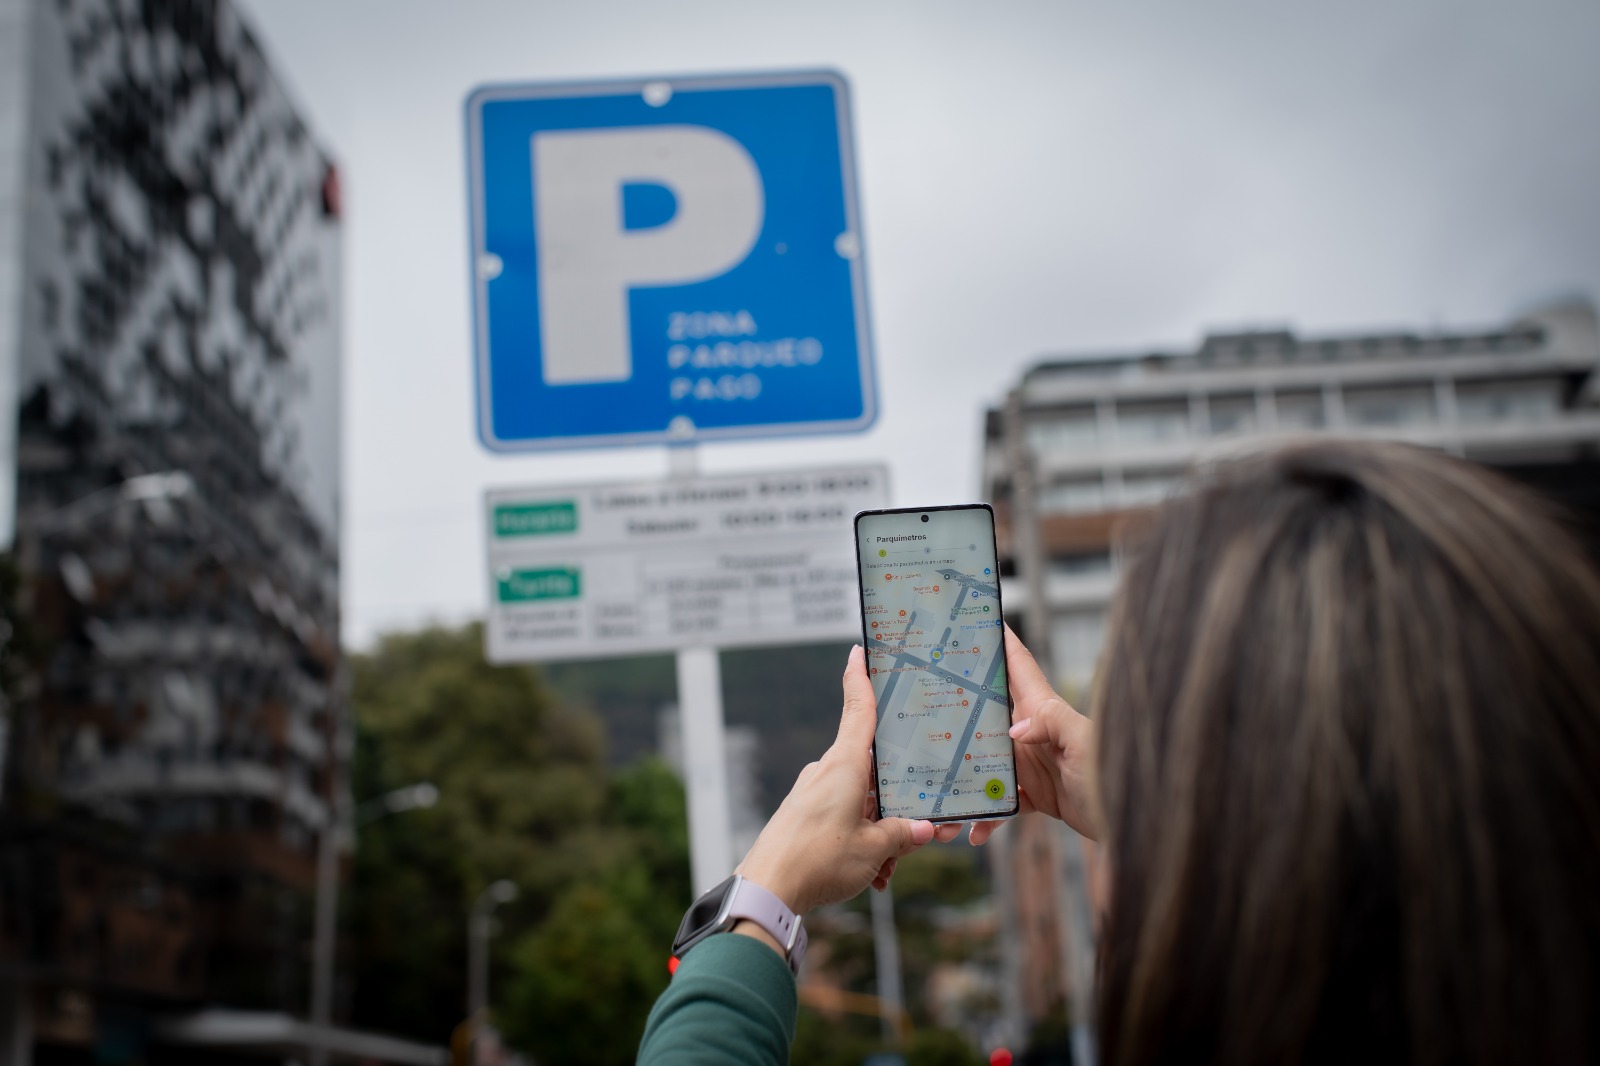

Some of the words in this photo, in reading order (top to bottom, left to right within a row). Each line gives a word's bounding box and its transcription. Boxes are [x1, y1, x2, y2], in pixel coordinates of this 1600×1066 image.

[530, 123, 766, 386] P
[668, 310, 757, 340] ZONA
[667, 337, 823, 368] PARQUEO
[670, 373, 762, 401] PAGO
